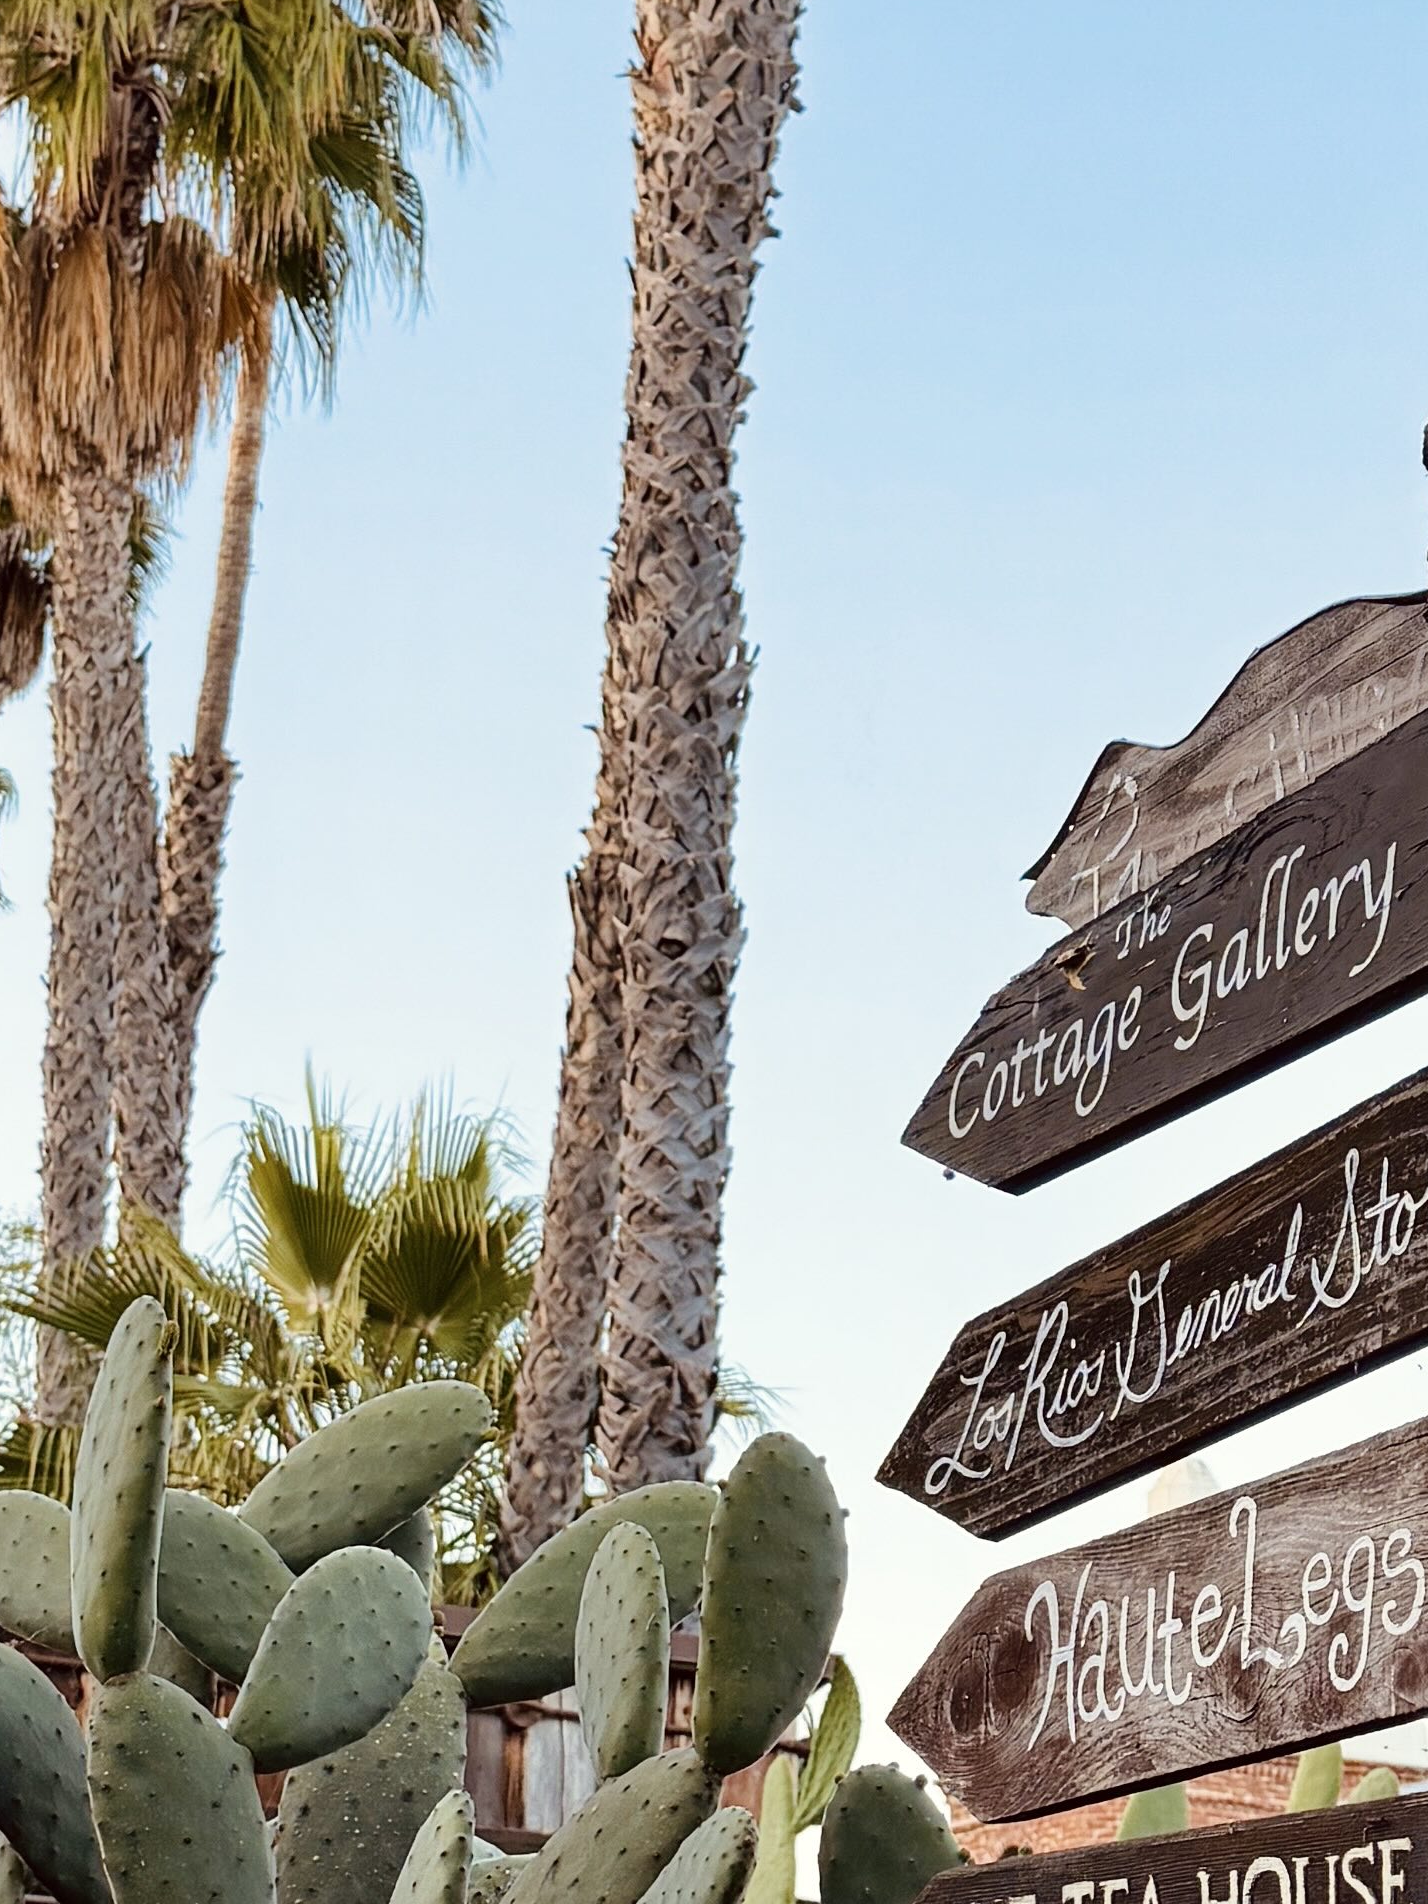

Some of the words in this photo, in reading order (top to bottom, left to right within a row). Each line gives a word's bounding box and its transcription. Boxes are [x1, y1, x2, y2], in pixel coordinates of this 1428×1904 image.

[946, 984, 1142, 1139] Cottage
[1171, 841, 1398, 1052] Gallery
[1115, 889, 1172, 961] The
[925, 1331, 1015, 1494] Los
[1005, 1301, 1107, 1470] Rios
[1110, 1201, 1302, 1423] General
[1023, 1561, 1229, 1751] Haute
[1228, 1496, 1427, 1691] Legs
